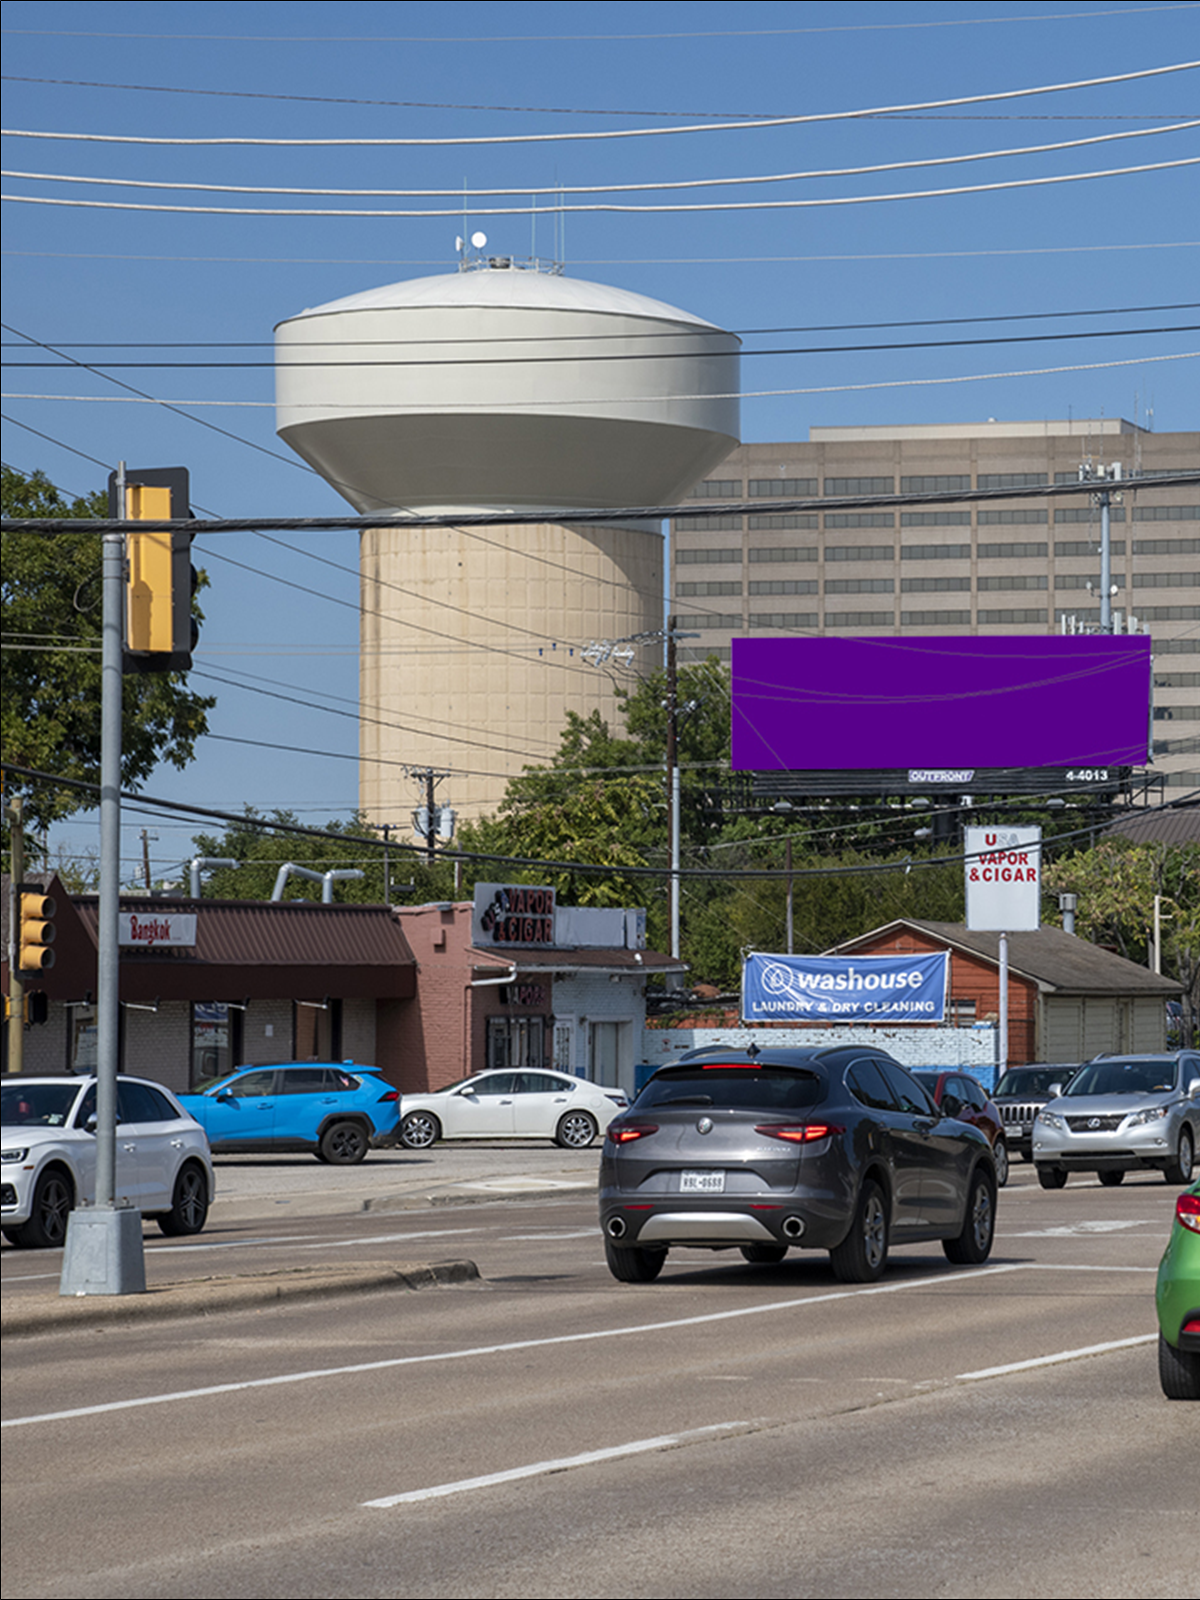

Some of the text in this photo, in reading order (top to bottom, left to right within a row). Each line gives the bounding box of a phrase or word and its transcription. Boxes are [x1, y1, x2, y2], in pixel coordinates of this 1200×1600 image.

[910, 770, 971, 782] OUTFRONT
[1065, 769, 1108, 781] 4-4013
[978, 851, 1029, 866] VAPOR
[507, 887, 554, 915] VAPOR
[129, 914, 172, 945] Bangkok
[508, 917, 553, 943] CIGAR
[797, 967, 923, 991] washouse
[752, 1001, 814, 1013] LAUNDRY
[832, 1002, 860, 1013] DRY
[863, 1001, 935, 1013] CLEANING
